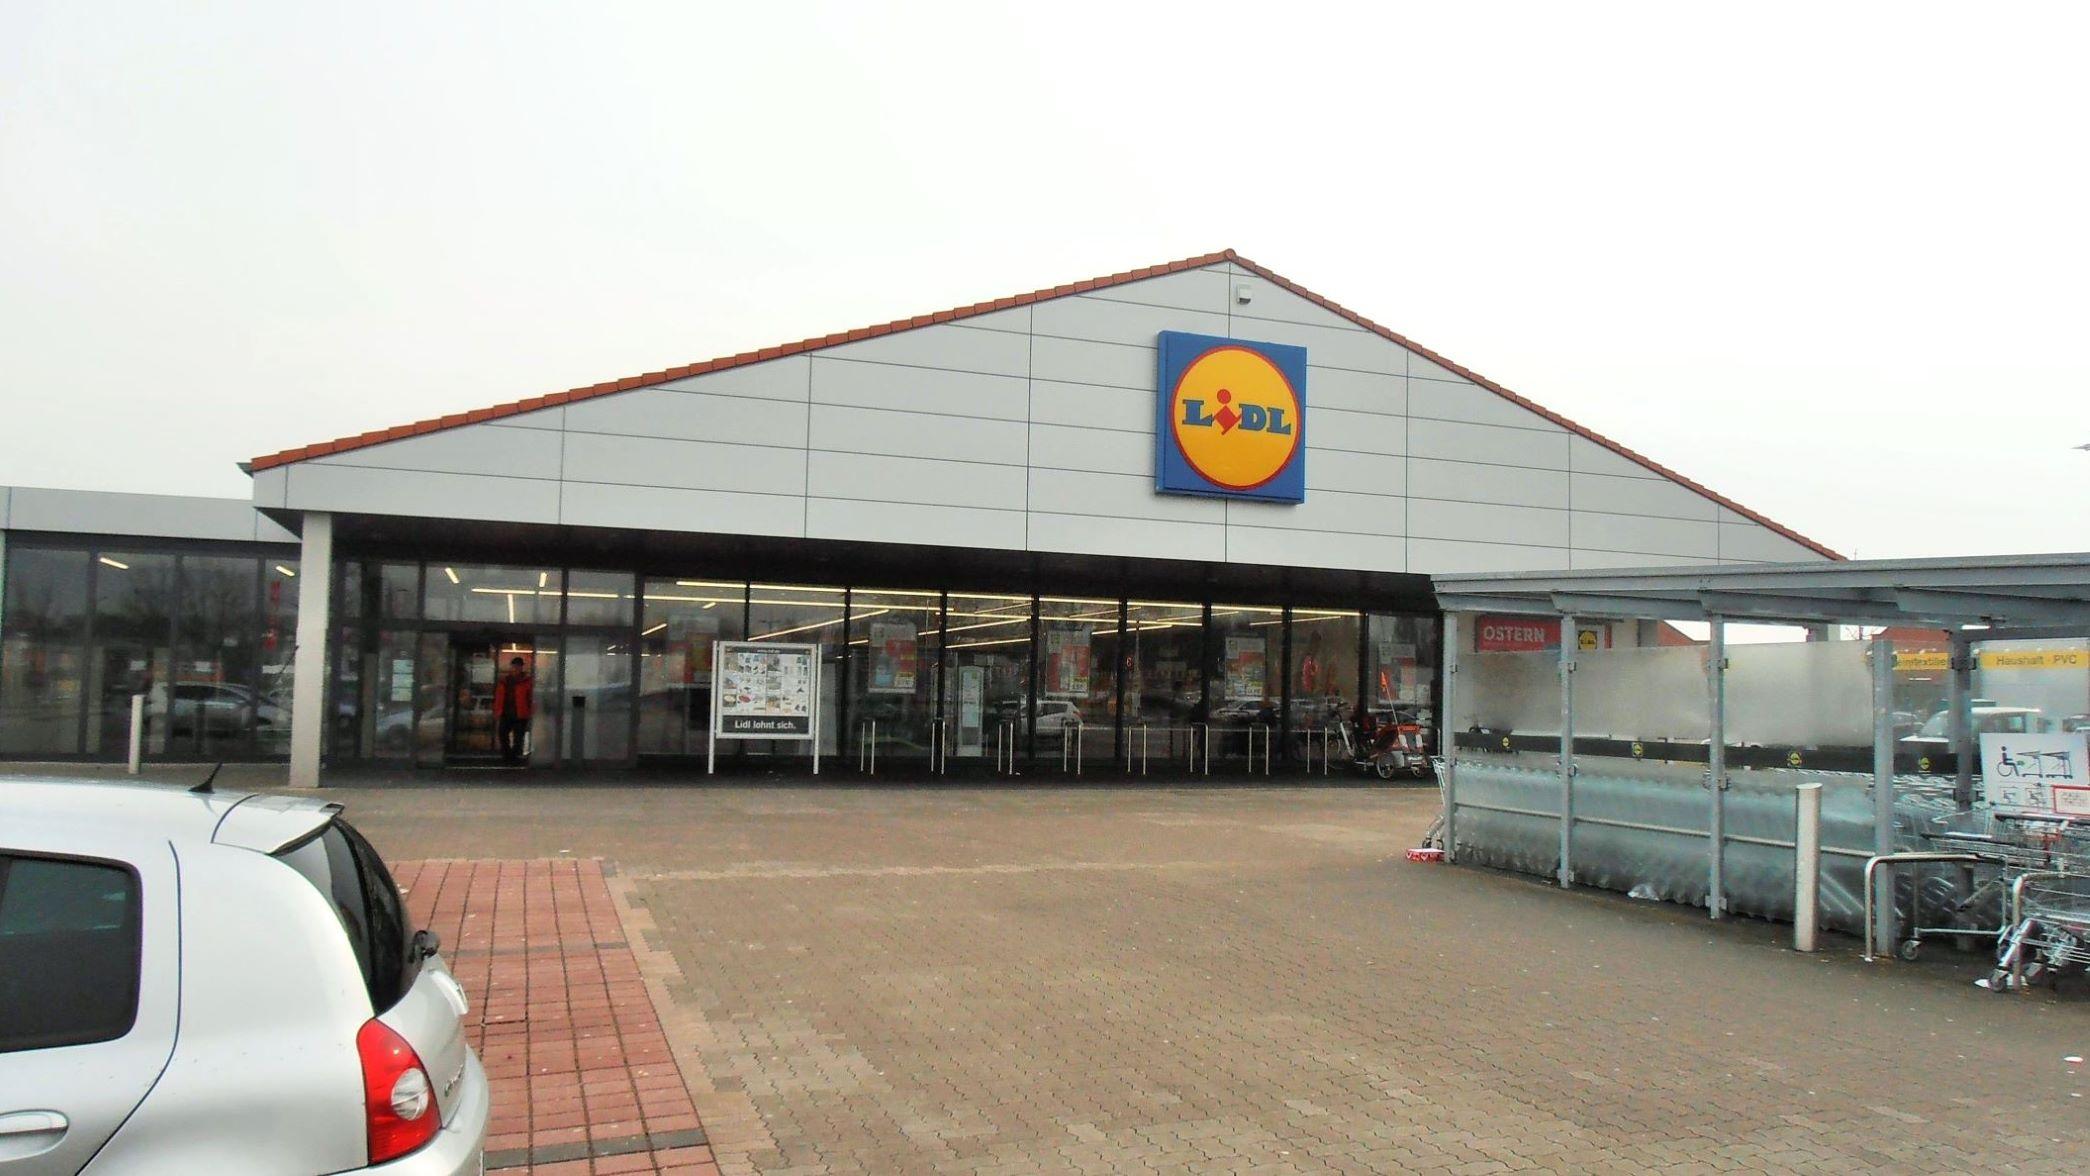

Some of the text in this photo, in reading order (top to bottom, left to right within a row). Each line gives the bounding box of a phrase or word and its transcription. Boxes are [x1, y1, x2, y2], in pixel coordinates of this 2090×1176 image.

[1483, 625, 1545, 642] OSTERN
[2053, 653, 2077, 665] PVC
[734, 719, 796, 730] Lidl lohnt sich.
